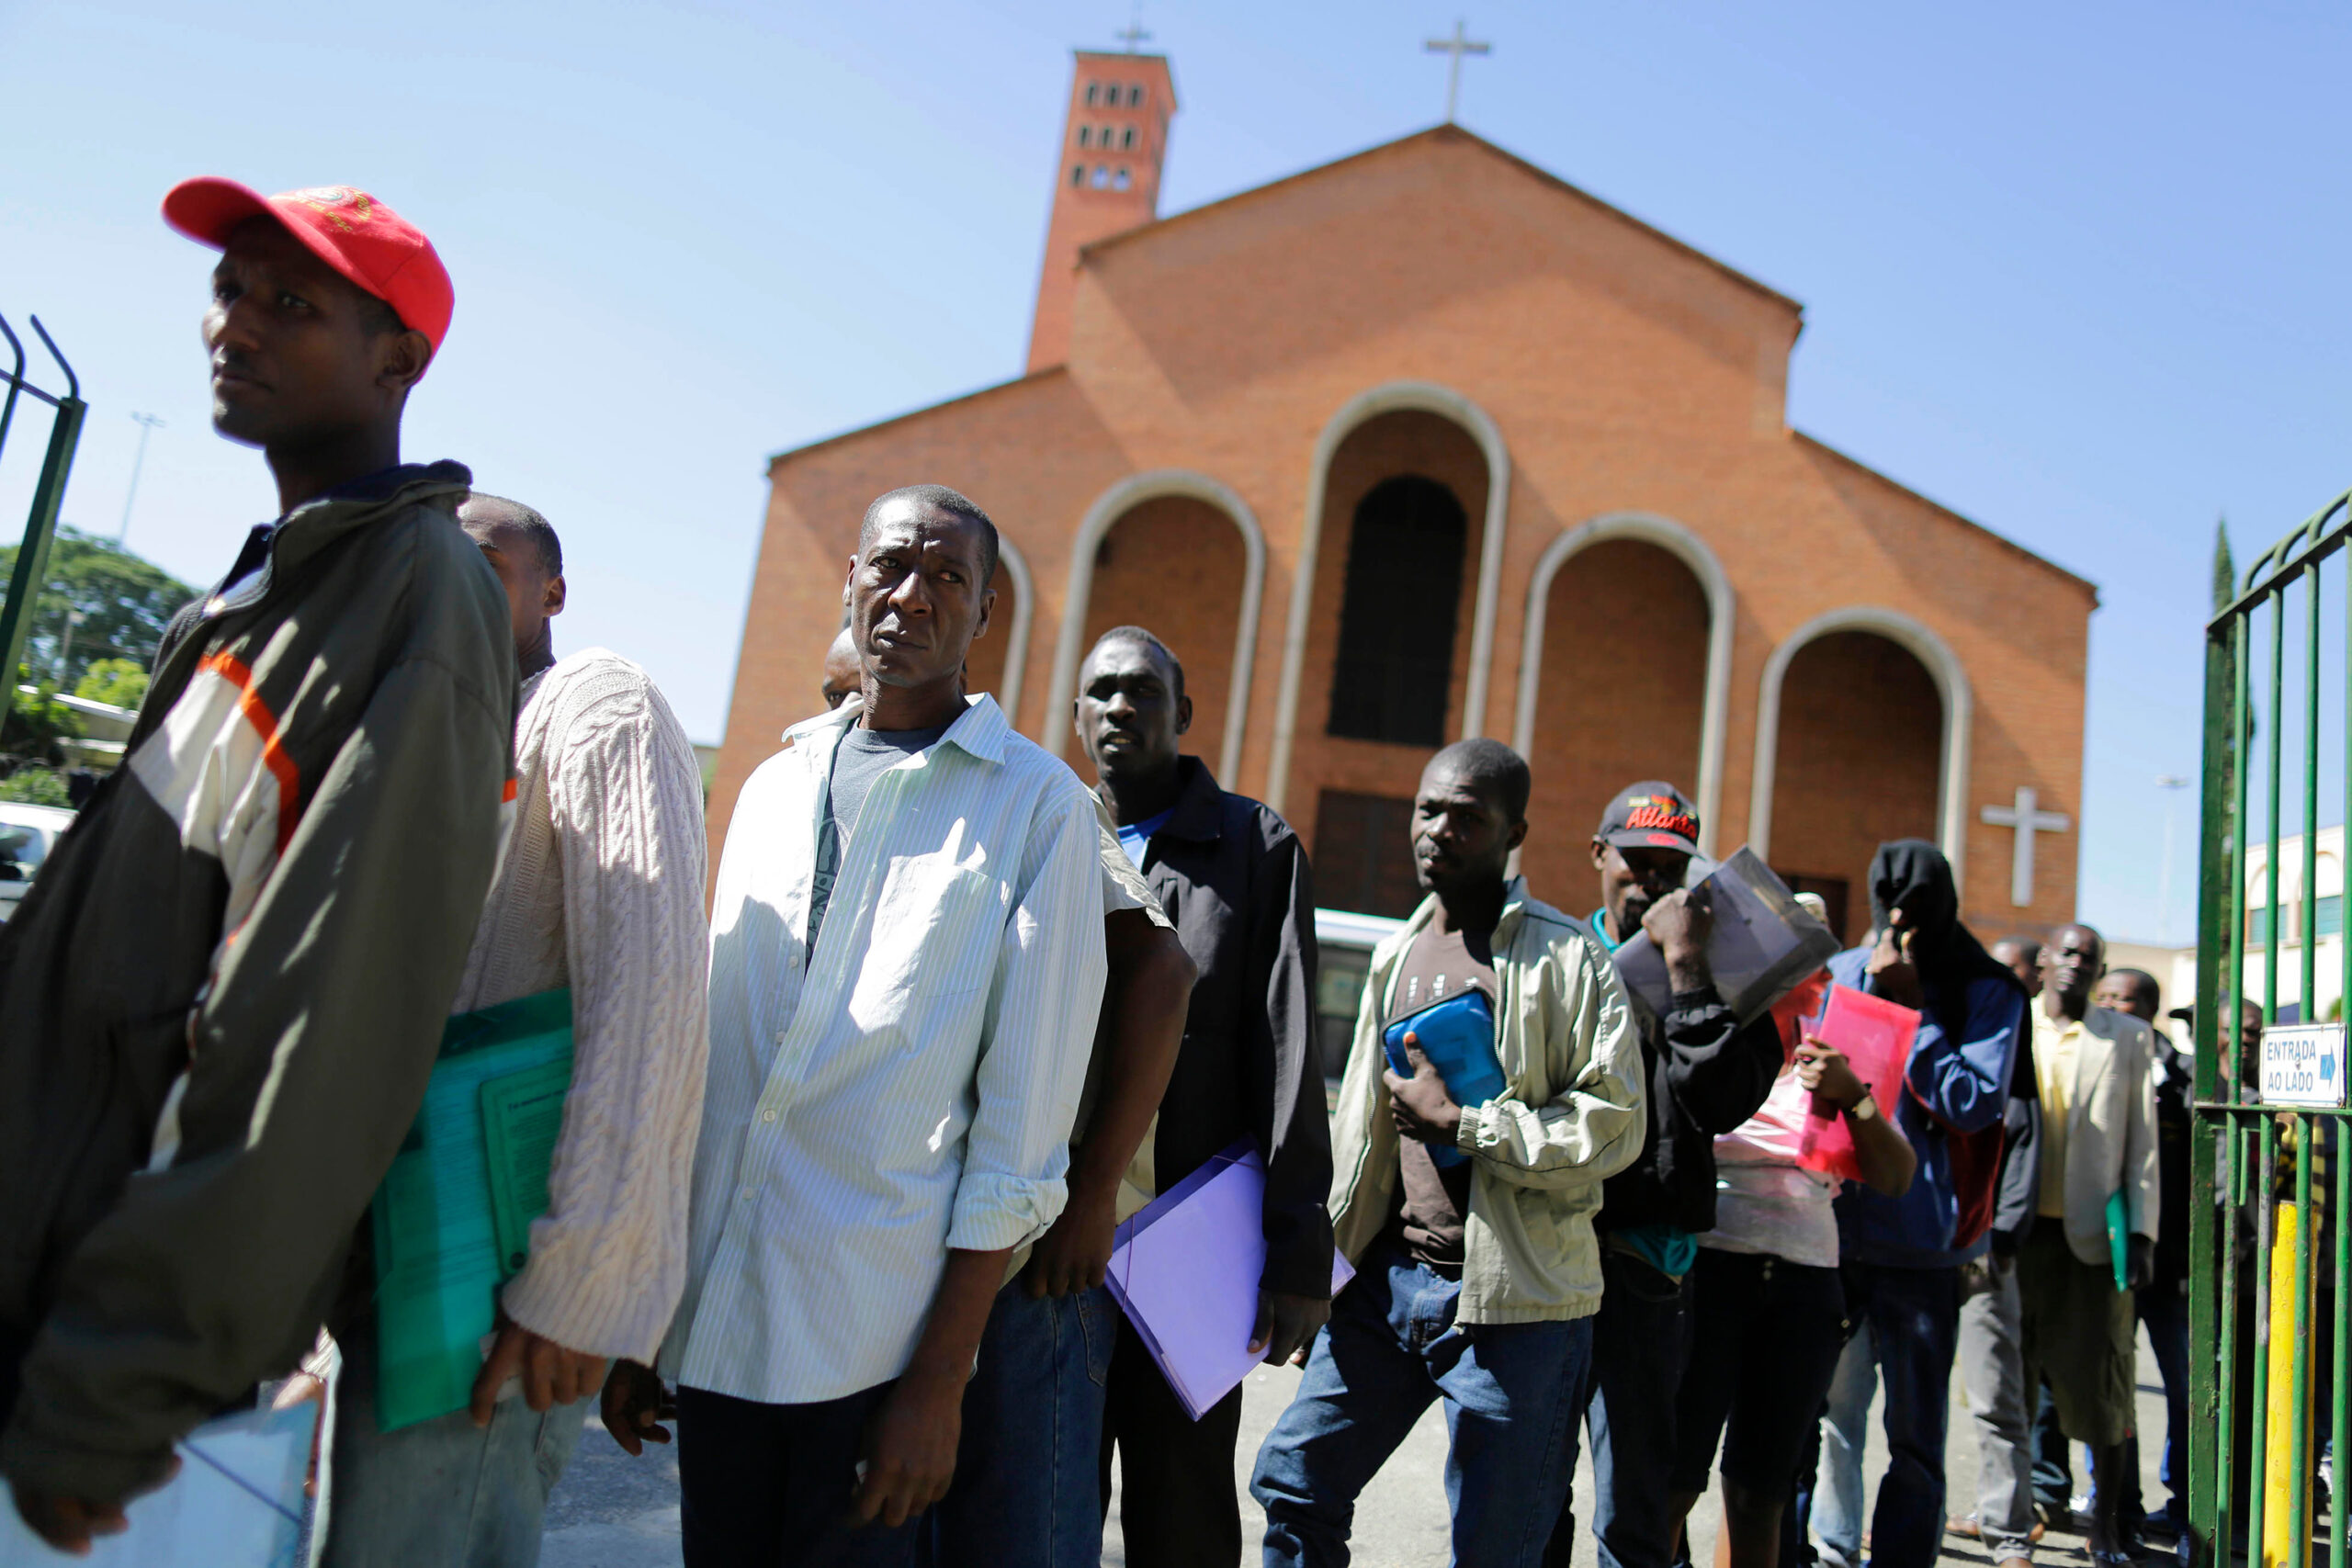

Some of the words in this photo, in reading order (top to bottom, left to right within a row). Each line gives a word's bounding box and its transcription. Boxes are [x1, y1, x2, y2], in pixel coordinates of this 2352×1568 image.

[2267, 1040, 2316, 1061] ENTRADA
[2267, 1072, 2282, 1091] AO
[2285, 1071, 2313, 1092] LADO
